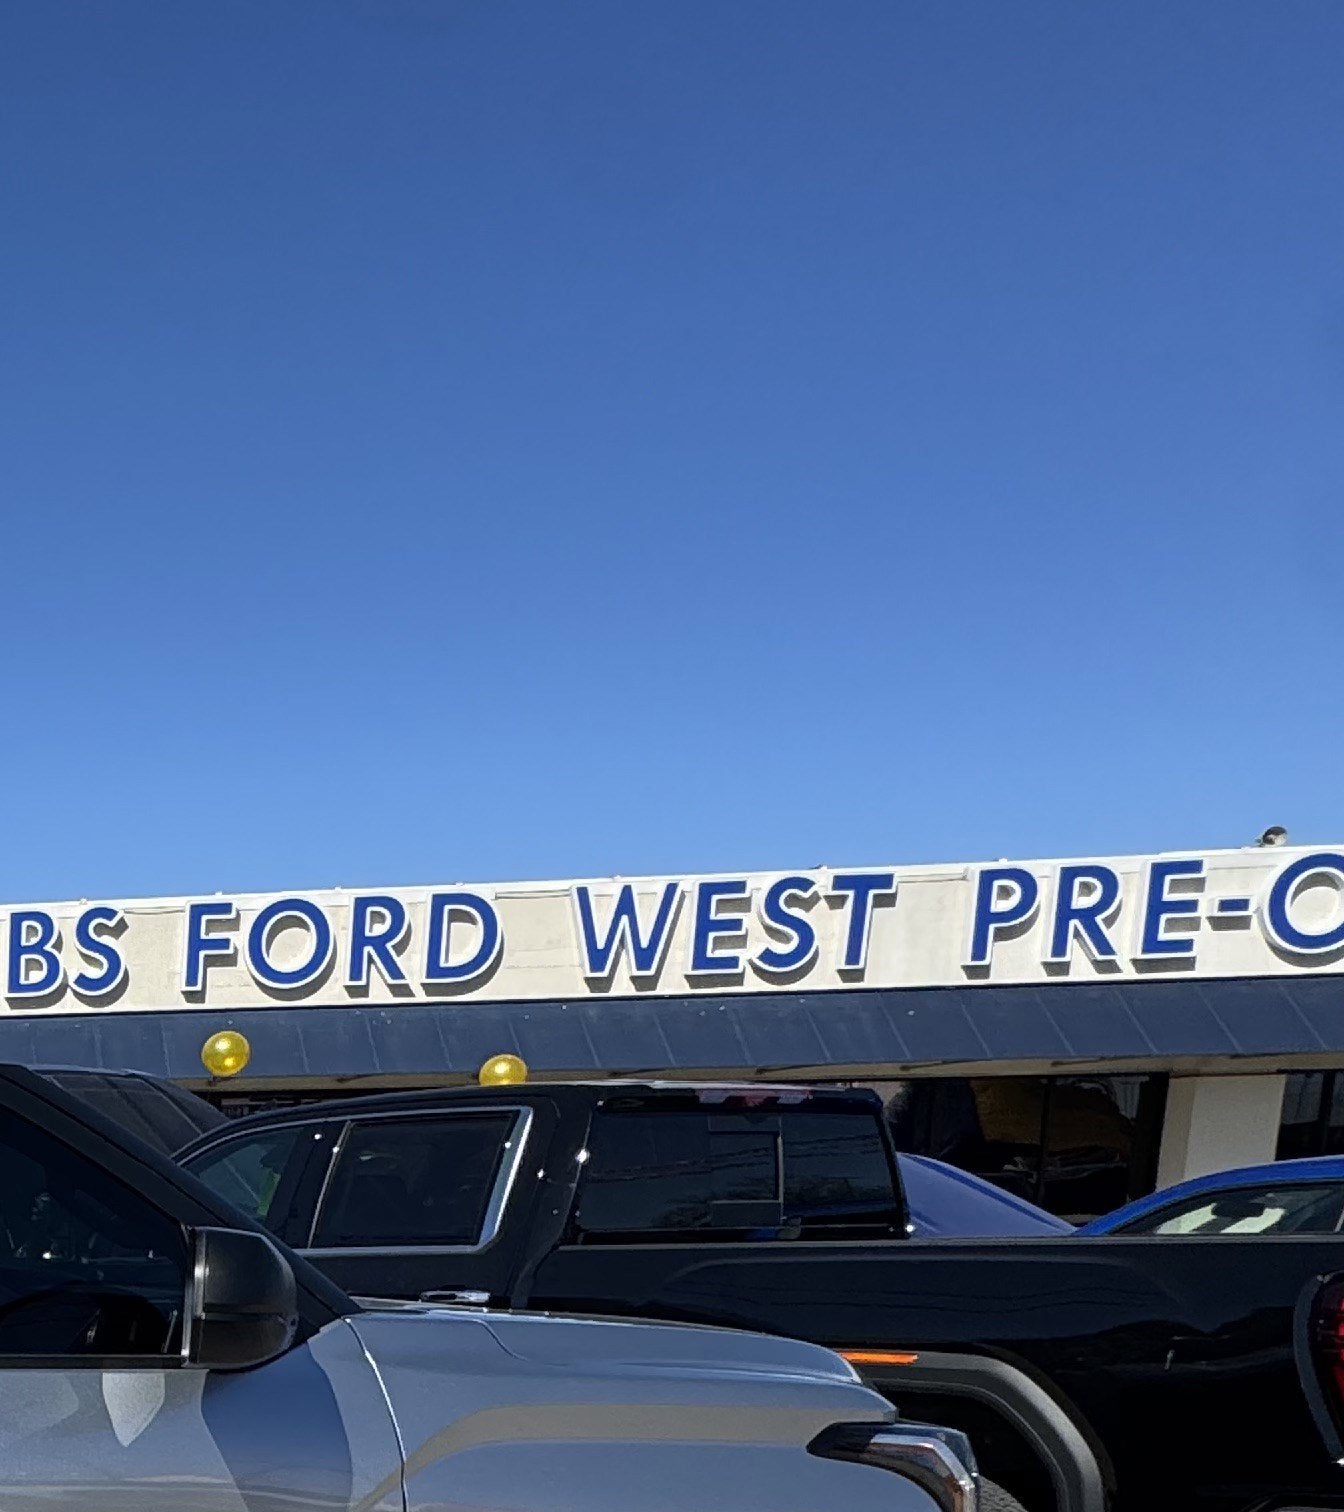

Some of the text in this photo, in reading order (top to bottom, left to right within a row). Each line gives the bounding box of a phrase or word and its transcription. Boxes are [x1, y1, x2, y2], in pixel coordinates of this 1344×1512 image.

[180, 889, 503, 992] FORD
[574, 868, 897, 977] WEST
[965, 850, 1344, 967] PRE-O
